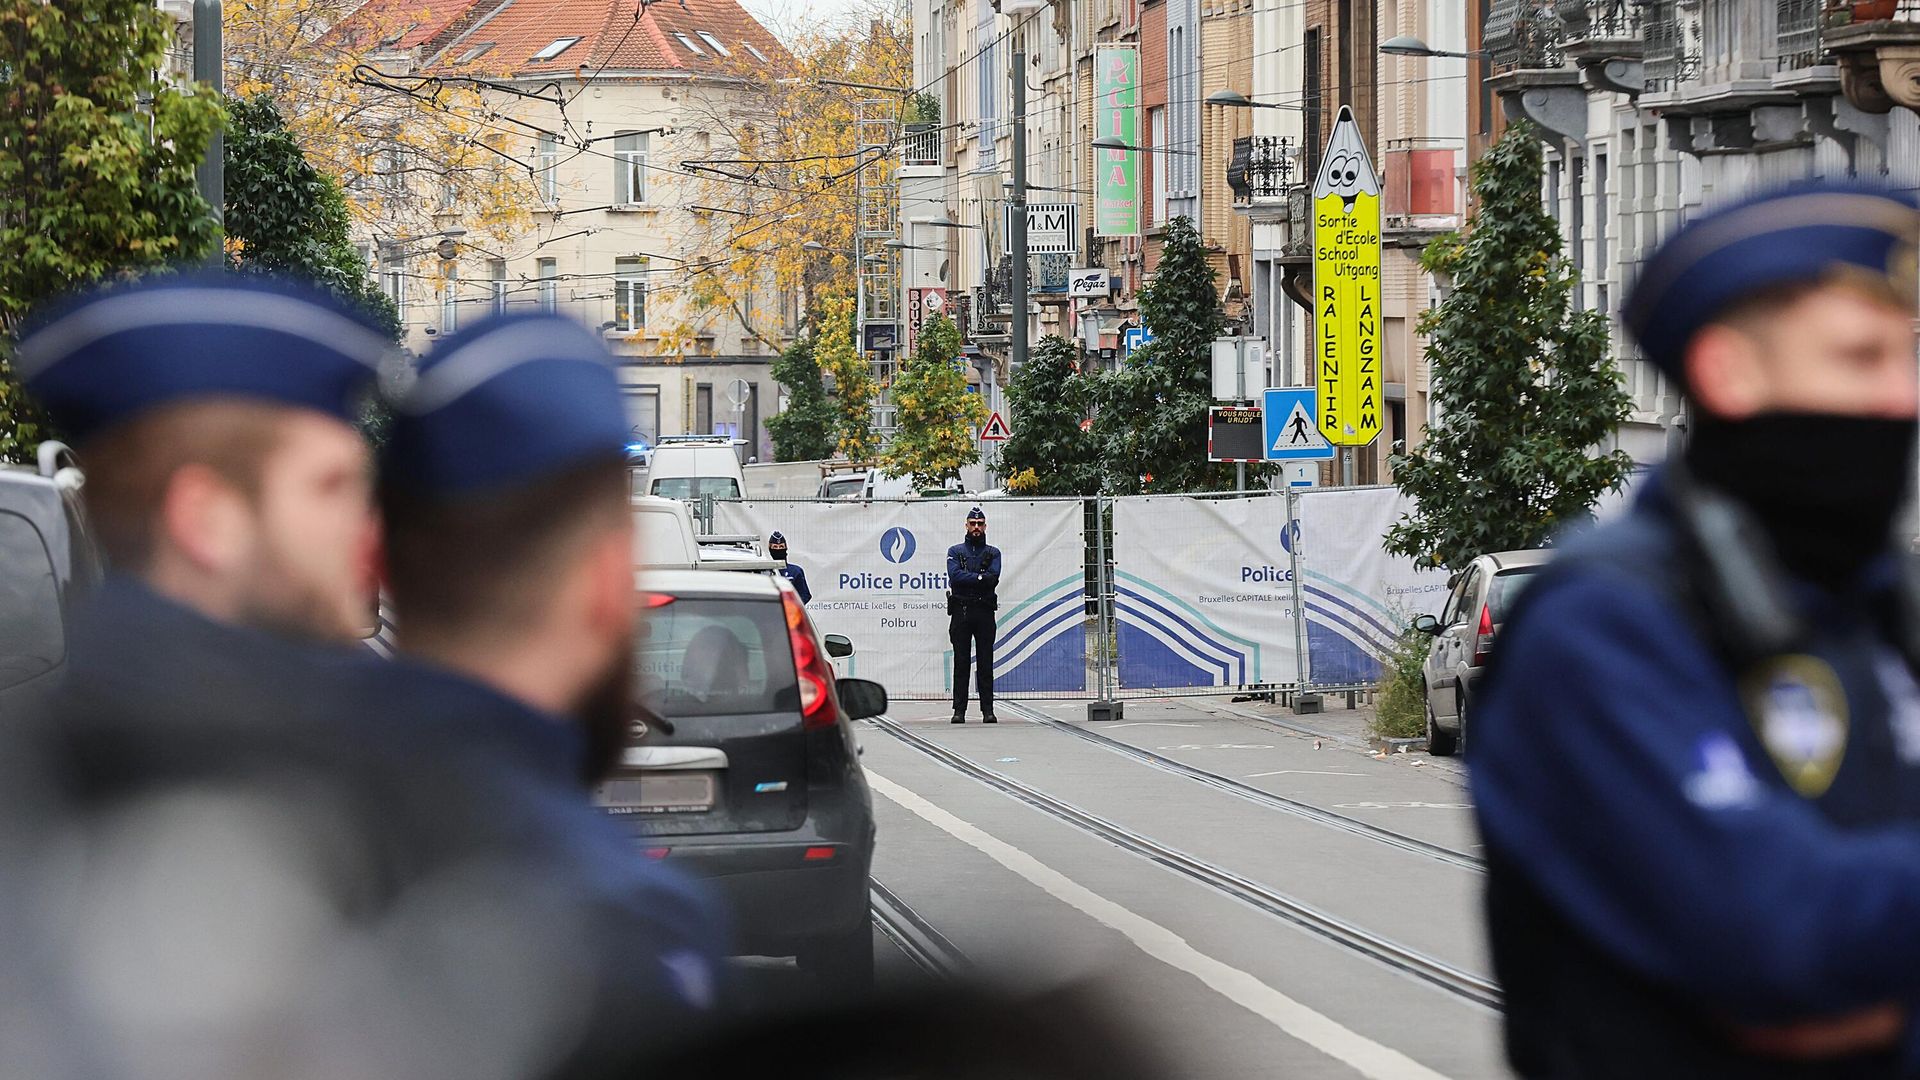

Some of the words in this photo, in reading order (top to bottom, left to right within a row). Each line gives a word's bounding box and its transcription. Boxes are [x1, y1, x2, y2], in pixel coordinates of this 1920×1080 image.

[1318, 214, 1358, 228] Sortie
[1335, 230, 1377, 245] d'Ecole
[1318, 245, 1359, 261] School
[1334, 263, 1378, 280] Uitgang
[1073, 278, 1106, 292] Pegaz
[1323, 286, 1339, 430] RALENTIR
[1359, 285, 1377, 430] LANGZAAM
[1298, 468, 1303, 477] 1
[839, 573, 893, 590] Police
[900, 572, 952, 590] Politi
[1241, 566, 1294, 582] Police
[833, 602, 869, 610] CAPITALE
[871, 602, 896, 610] Ixelles
[903, 602, 929, 610] Brussel
[1199, 595, 1235, 603] Bruxelles
[1236, 594, 1272, 603] CAPITALE
[881, 618, 917, 628] Polbru
